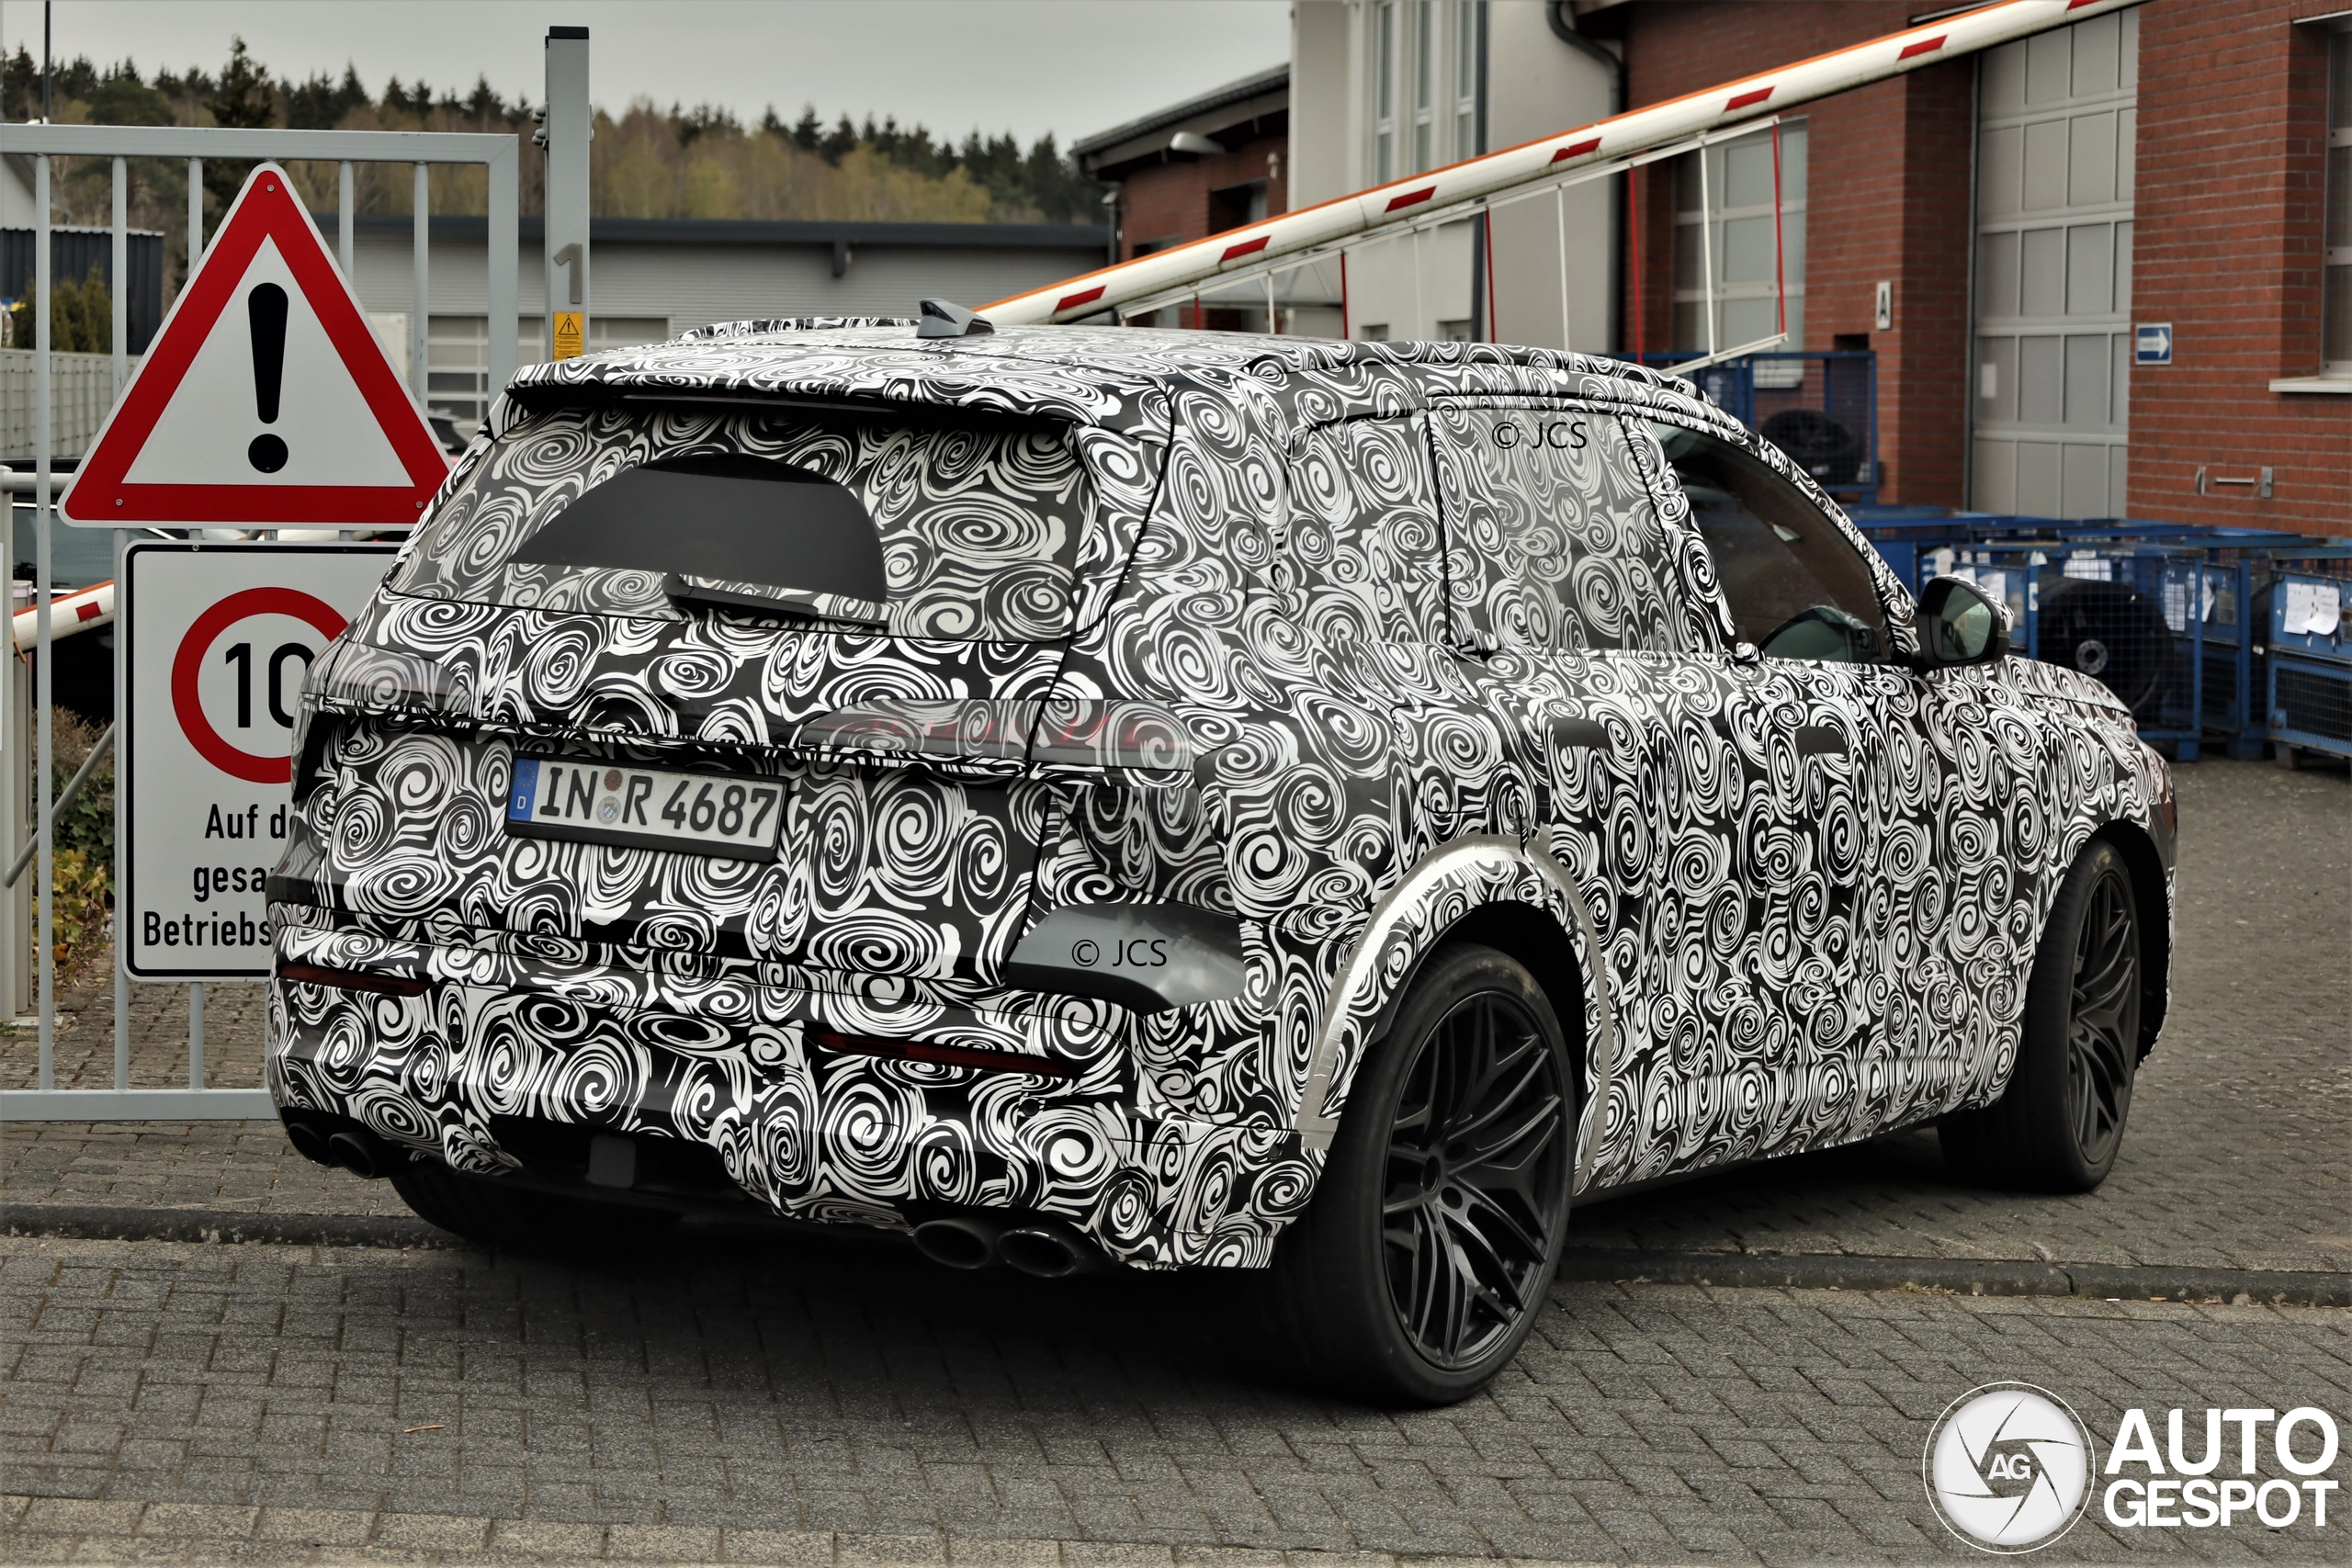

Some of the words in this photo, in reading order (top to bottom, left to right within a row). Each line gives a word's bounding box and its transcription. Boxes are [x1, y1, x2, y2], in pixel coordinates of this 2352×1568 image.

[553, 243, 582, 304] 1
[225, 642, 315, 728] 10
[516, 795, 526, 810] D
[539, 766, 598, 819] IN
[622, 775, 653, 826] R
[661, 781, 778, 838] 4687
[205, 804, 258, 839] Auf
[270, 804, 294, 839] d
[193, 866, 275, 902] gesa
[143, 910, 272, 946] Betriebs
